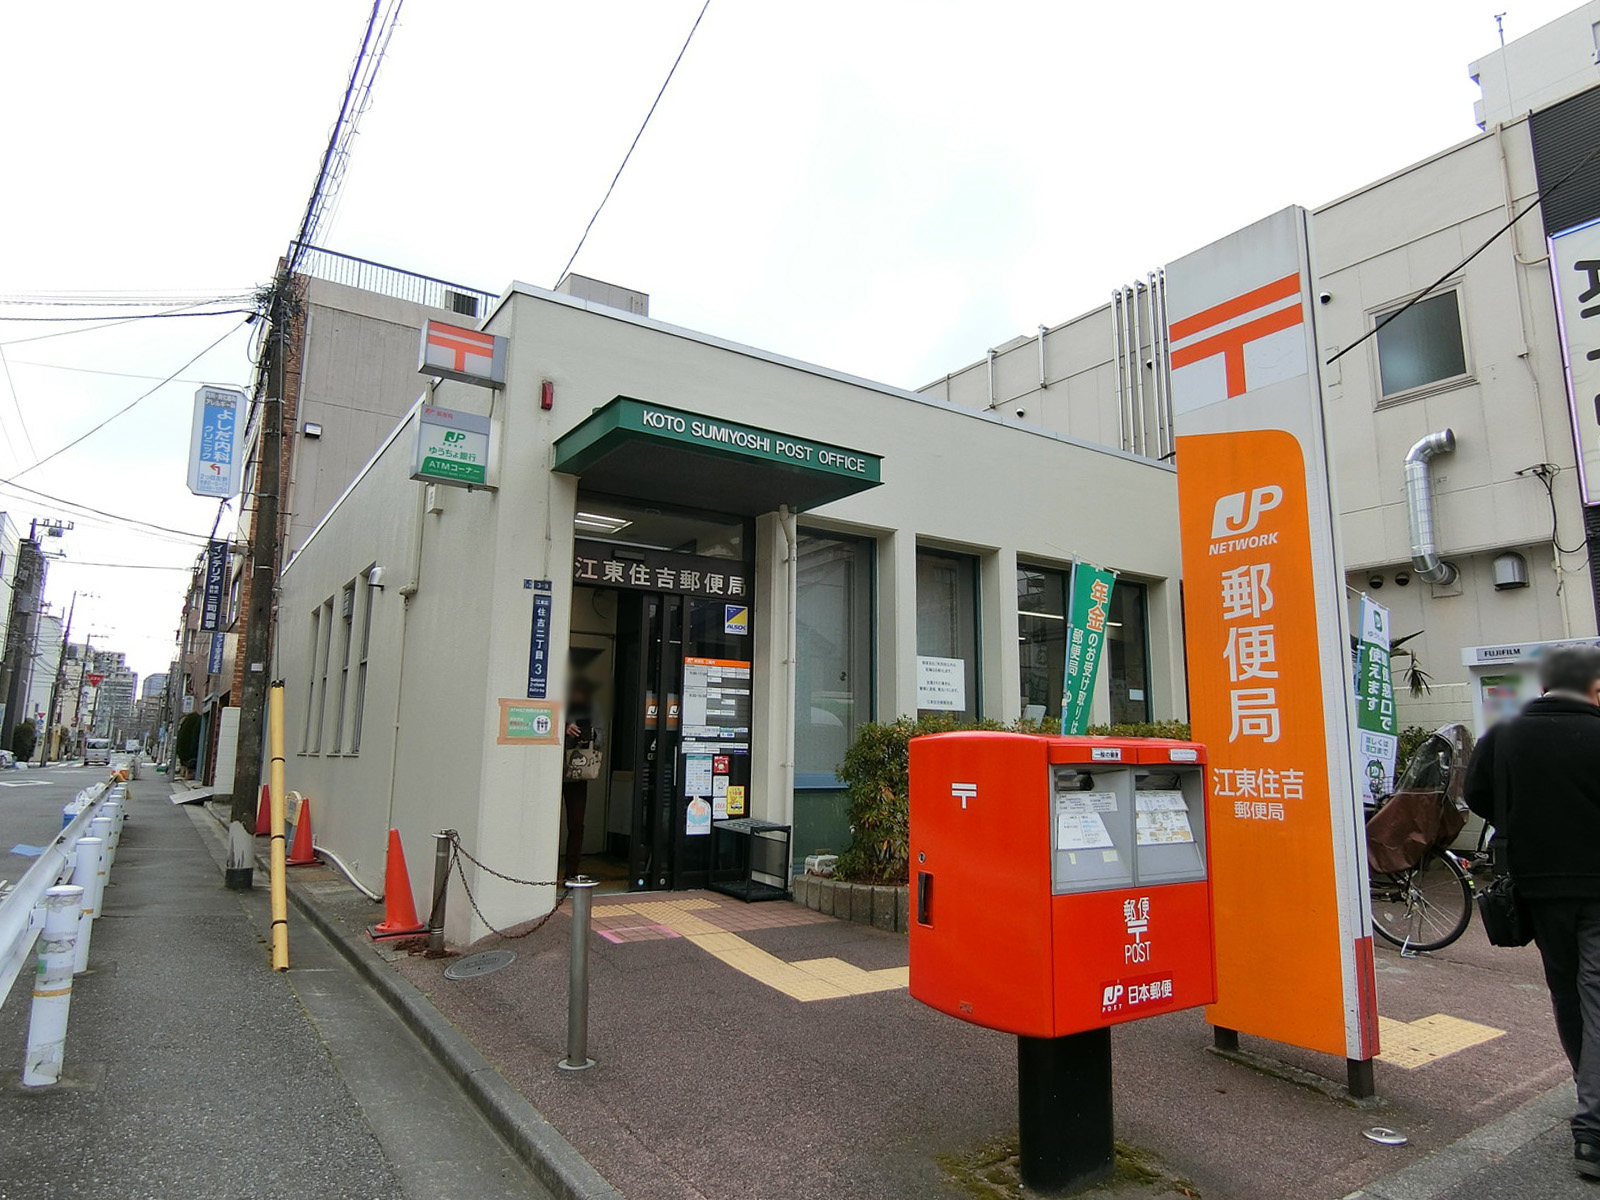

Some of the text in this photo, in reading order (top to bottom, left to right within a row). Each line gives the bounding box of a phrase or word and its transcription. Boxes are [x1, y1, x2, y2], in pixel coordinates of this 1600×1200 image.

[202, 425, 214, 460] クリニック
[213, 409, 233, 463] よしだ内科
[643, 410, 866, 473] KOTO SUMIYOSHI POST OFFICE
[428, 446, 477, 462] ゆうちょ銀行
[428, 460, 480, 474] ATMコーナー
[1211, 484, 1283, 539] JP
[1208, 531, 1279, 556] NETWORK
[210, 544, 224, 583] インテリア
[574, 556, 746, 597] 江東住吉郵便局
[535, 607, 546, 660] 住吉二丁目
[1221, 562, 1281, 744] 郵便局
[1484, 648, 1520, 657] FUJIFILM
[534, 663, 542, 675] 3
[1366, 646, 1382, 711] 使えます
[1213, 767, 1305, 800] 江東住吉
[1234, 801, 1285, 821] 郵便局
[1123, 897, 1150, 922] 郵便
[1124, 941, 1151, 965] POST
[1102, 984, 1124, 1006] JP
[1128, 979, 1173, 1005] 日本郵便
[1102, 1003, 1122, 1013] POST
